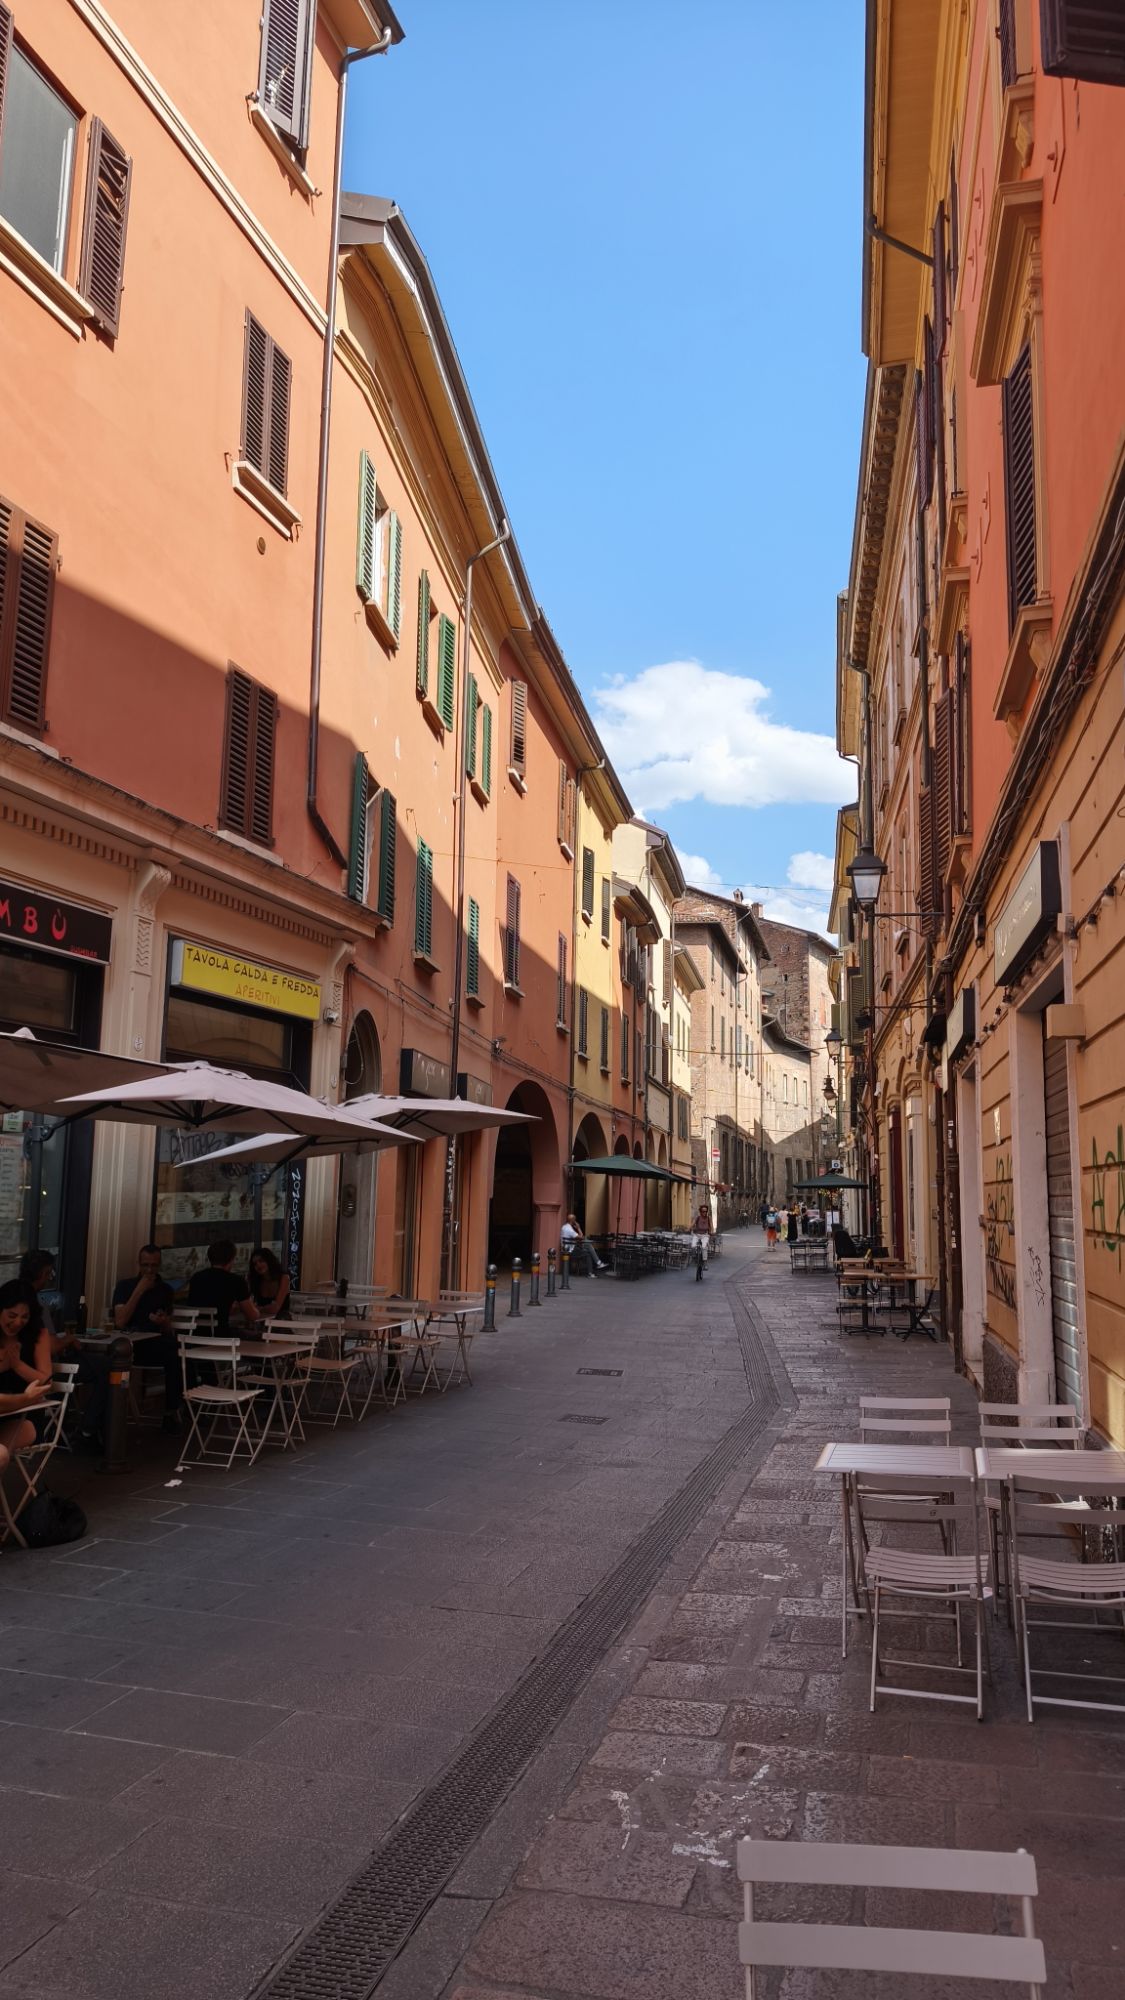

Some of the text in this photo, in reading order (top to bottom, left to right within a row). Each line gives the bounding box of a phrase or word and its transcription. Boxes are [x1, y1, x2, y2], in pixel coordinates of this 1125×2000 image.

[186, 947, 319, 998] TAVOLA CALDA E FREDDA
[234, 983, 280, 1006] APERITIVI
